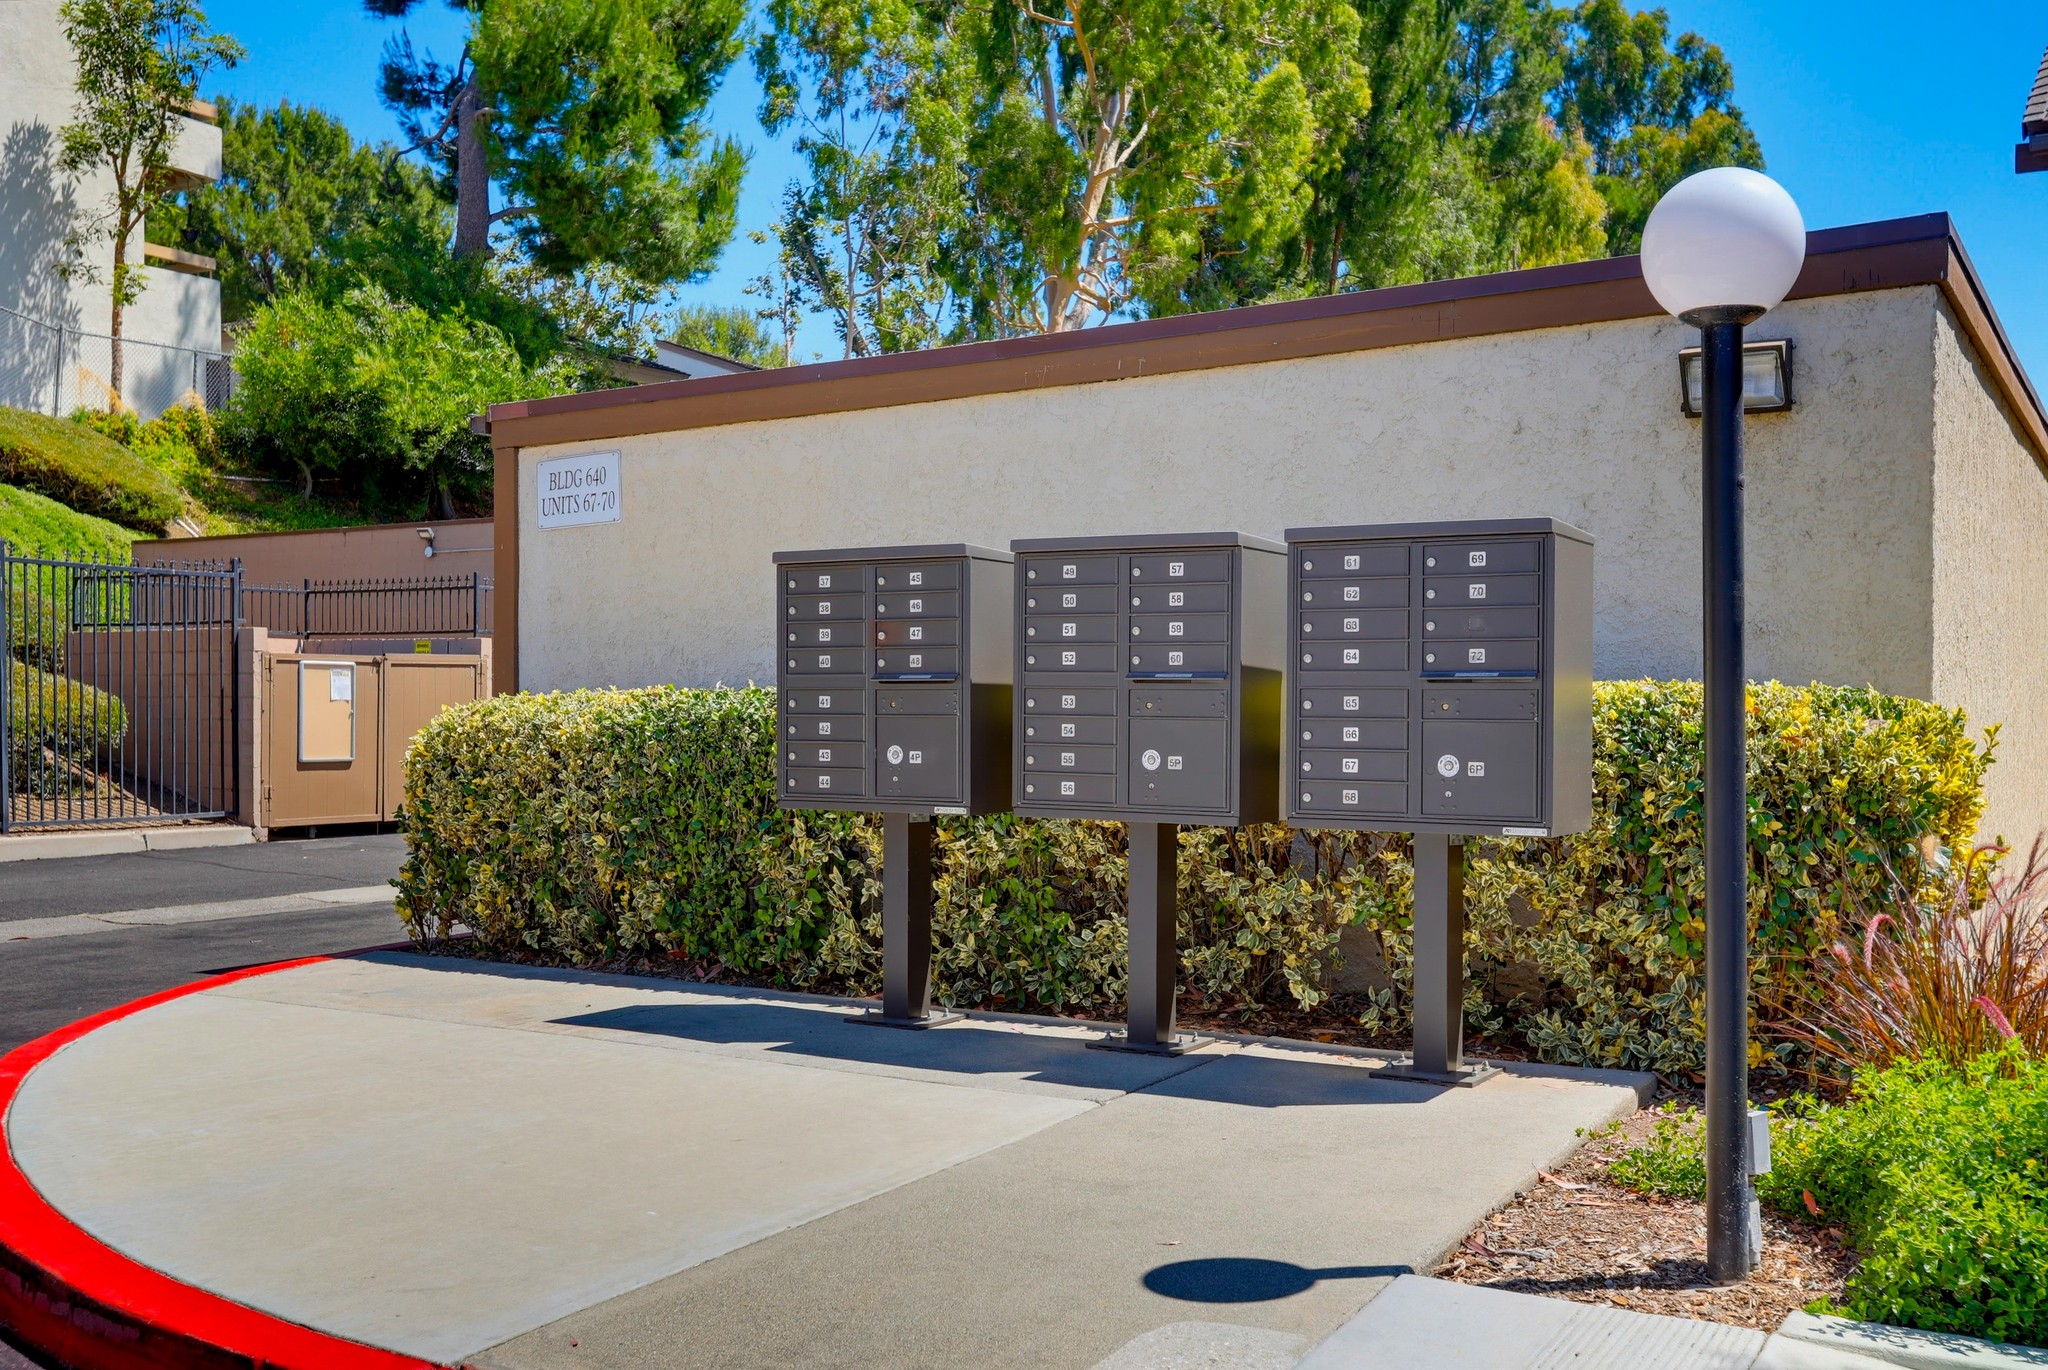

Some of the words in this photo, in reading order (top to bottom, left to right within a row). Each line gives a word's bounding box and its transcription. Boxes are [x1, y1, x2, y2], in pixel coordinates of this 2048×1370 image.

[549, 469, 582, 491] BLDG
[585, 466, 607, 487] 640
[541, 494, 580, 517] UNITS
[583, 490, 615, 512] 67-70
[1345, 558, 1357, 568] 61
[1471, 553, 1485, 564] 69
[1064, 567, 1075, 577] 49
[1171, 564, 1183, 574] 57
[820, 577, 829, 587] 37
[910, 574, 921, 583] 45
[1345, 589, 1359, 599] 62
[1471, 586, 1484, 597] 70
[1064, 596, 1075, 606] 50
[1170, 594, 1182, 604] 58
[819, 604, 830, 613] 38
[910, 601, 921, 610] 46
[1064, 625, 1074, 635] 51
[1170, 624, 1182, 634] 59
[1345, 620, 1358, 631] 63
[820, 630, 830, 640] 39
[910, 628, 921, 638] 47
[819, 657, 830, 666] 40
[910, 656, 921, 666] 48
[1063, 653, 1075, 663] 52
[1170, 654, 1182, 664] 60
[1345, 651, 1358, 662] 64
[1470, 651, 1484, 662] 72
[819, 698, 829, 706] 41
[1063, 697, 1074, 707] 53
[1345, 698, 1358, 709] 65
[819, 724, 830, 733] 42
[1063, 726, 1074, 735] 54
[1344, 729, 1358, 740] 66
[819, 751, 830, 760] 43
[909, 752, 921, 762] 4P
[1062, 755, 1074, 765] 55
[1169, 758, 1182, 768] 5P
[1344, 760, 1357, 771] 67
[1468, 764, 1484, 775] 6P
[819, 778, 830, 786] 44
[1062, 783, 1074, 793] 56
[1344, 792, 1357, 802] 68
